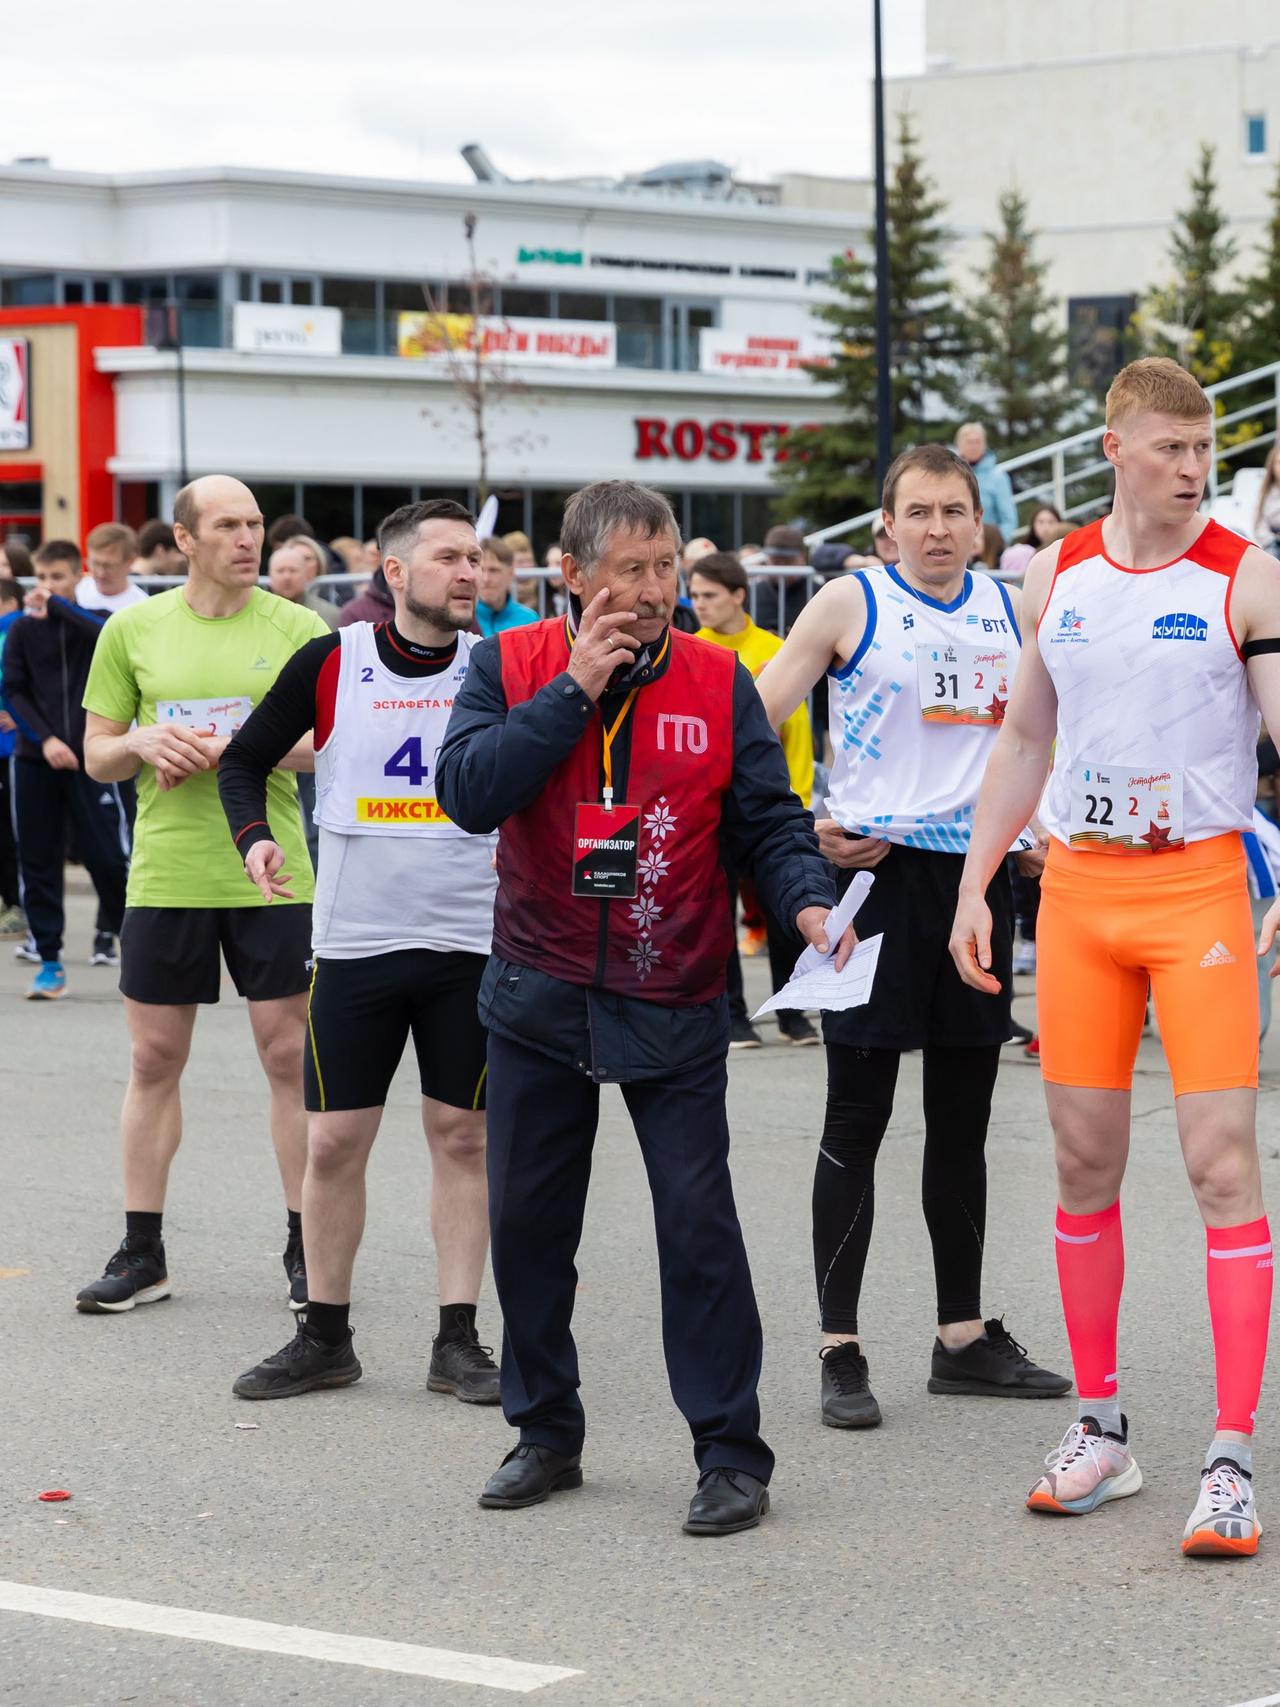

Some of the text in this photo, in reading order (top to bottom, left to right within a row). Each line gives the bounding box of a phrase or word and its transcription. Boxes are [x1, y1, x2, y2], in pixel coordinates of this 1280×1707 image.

[1153, 626, 1207, 638] КУПОЛ
[360, 667, 374, 682] 2
[934, 672, 984, 699] 31 2
[373, 699, 440, 709] ЭСТАФЕТА
[656, 712, 709, 754] ГТО
[384, 736, 429, 786] 4
[1127, 772, 1171, 791] Эстафета
[1085, 794, 1139, 826] 22 2
[578, 838, 635, 851] ОРГАНИЗАТОР
[1199, 955, 1237, 968] adidas
